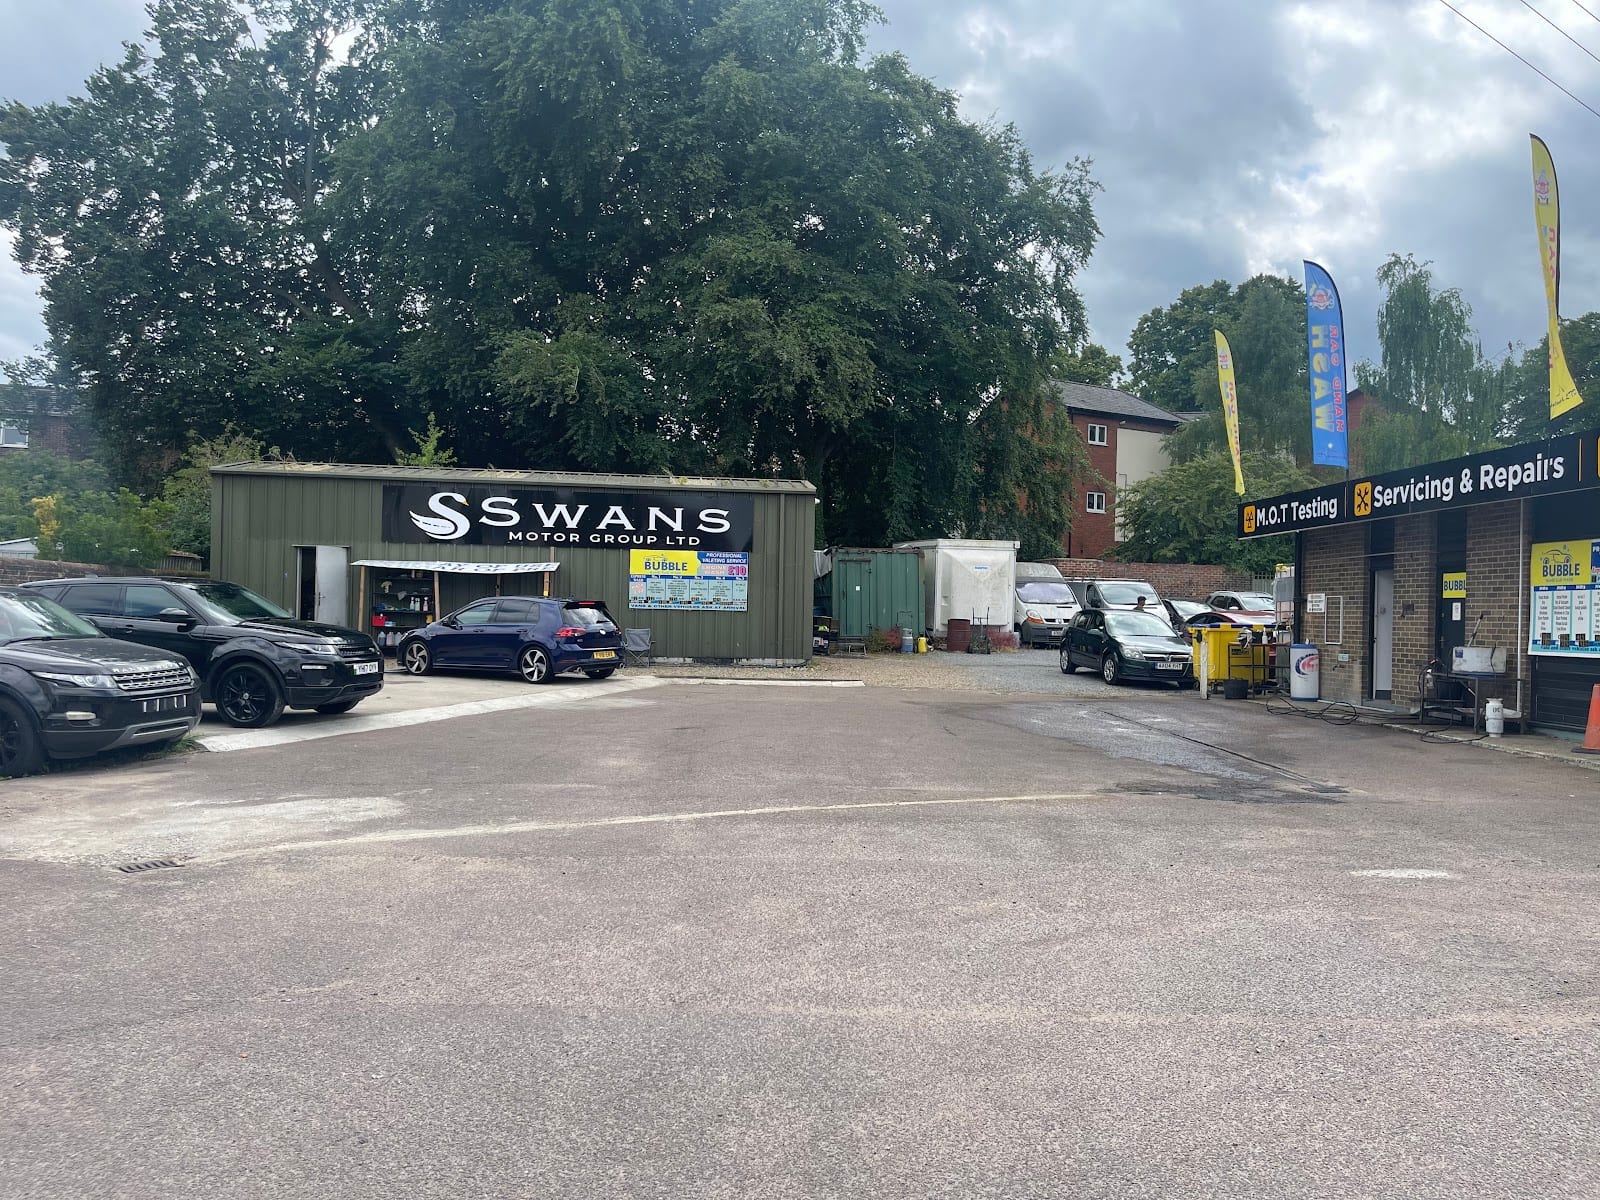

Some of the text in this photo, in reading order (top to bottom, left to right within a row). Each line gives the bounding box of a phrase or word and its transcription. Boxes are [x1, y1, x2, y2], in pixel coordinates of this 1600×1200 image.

[1373, 476, 1453, 508] Servicing
[1459, 468, 1473, 494] &
[478, 496, 732, 534] SWANS
[1256, 496, 1338, 527] M.O.T Testing
[509, 531, 701, 546] MOTOR GROUP LTD
[644, 561, 688, 571] BUBBLE
[727, 566, 747, 576] £10
[1542, 564, 1580, 577] BUBBLE
